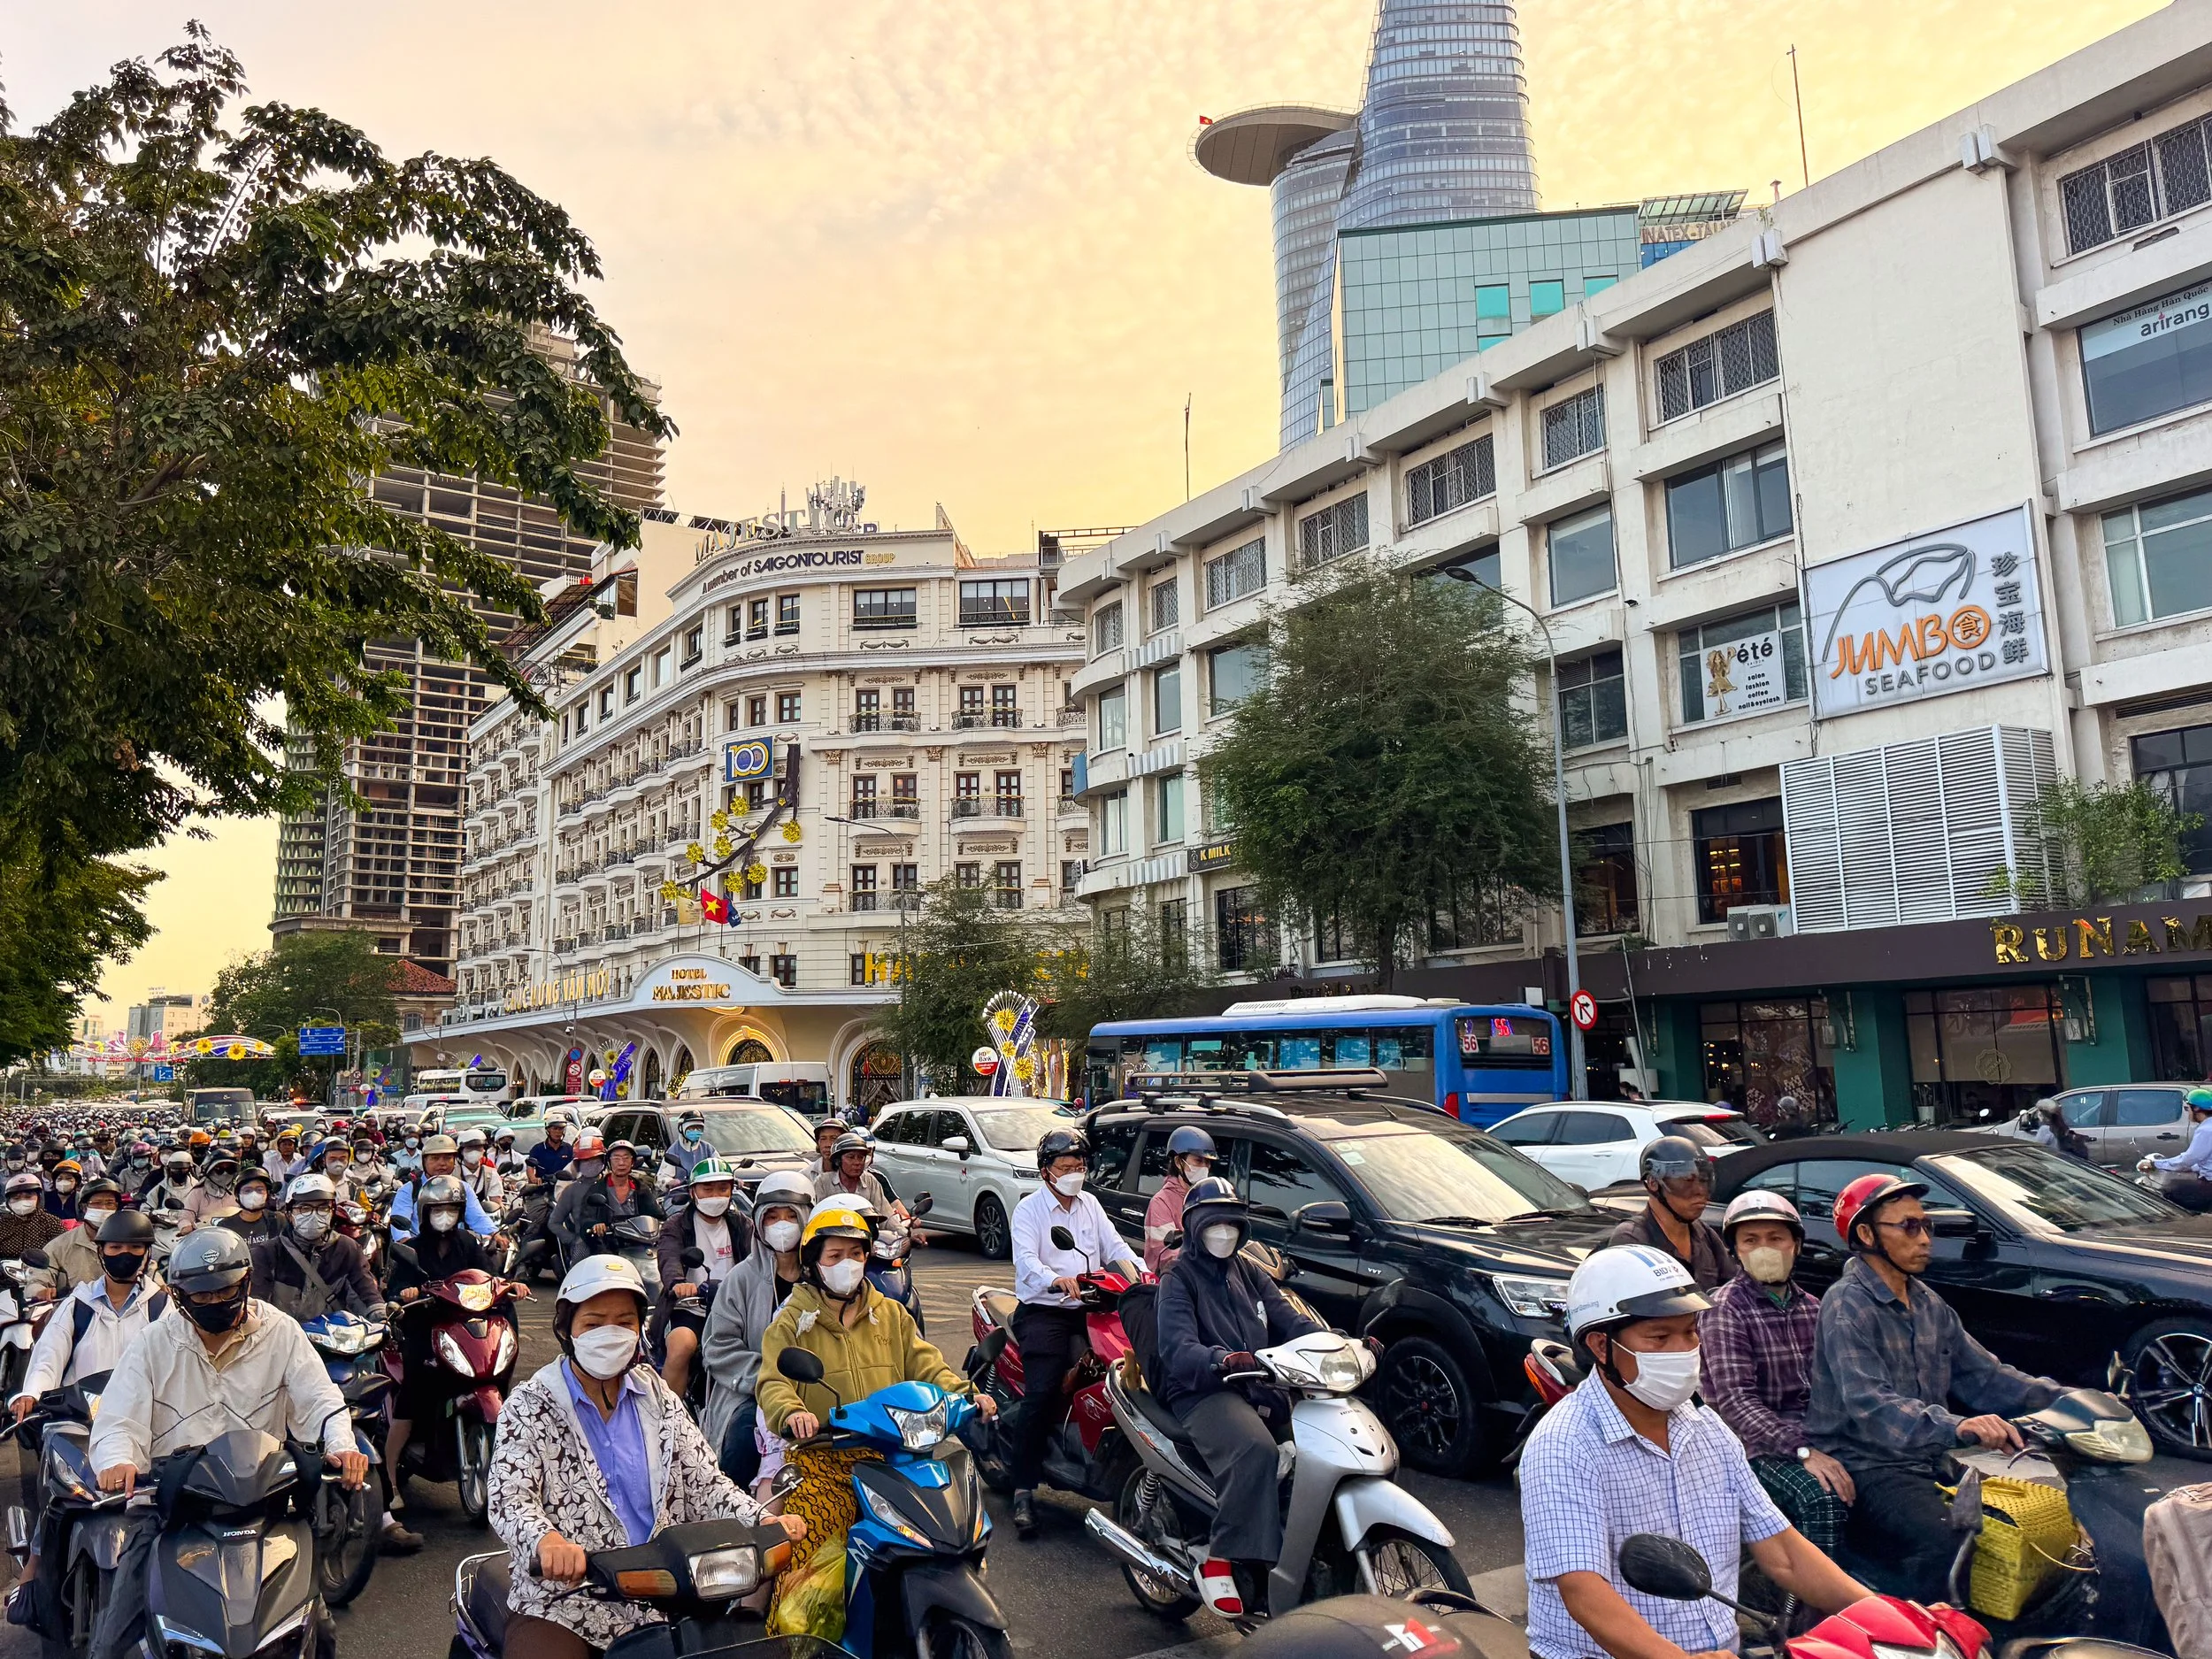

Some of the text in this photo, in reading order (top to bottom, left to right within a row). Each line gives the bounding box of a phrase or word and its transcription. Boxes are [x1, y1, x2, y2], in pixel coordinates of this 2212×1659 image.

[2113, 285, 2208, 326] Nhà Hàng Hàn Quốc
[2140, 303, 2209, 336] arirang
[695, 507, 855, 565] MAJESTIC
[702, 549, 895, 595] A member of SAIGONTOURIST GROUP
[1737, 637, 1773, 664] été
[1829, 604, 1992, 680] JUMBO
[1747, 672, 1765, 681] salon
[1865, 652, 1996, 695] SEAFOOD
[1746, 680, 1770, 690] fashion
[1747, 690, 1769, 699] coffee
[728, 741, 769, 778] 100
[1200, 844, 1231, 861] K MILK
[1989, 914, 2212, 964] RUNAM
[672, 968, 707, 979] HOTEL
[652, 983, 731, 1000] MAJESTIC
[1463, 1035, 1477, 1051] 56
[1532, 1038, 1549, 1053] 56
[223, 1529, 257, 1538] HONDA
